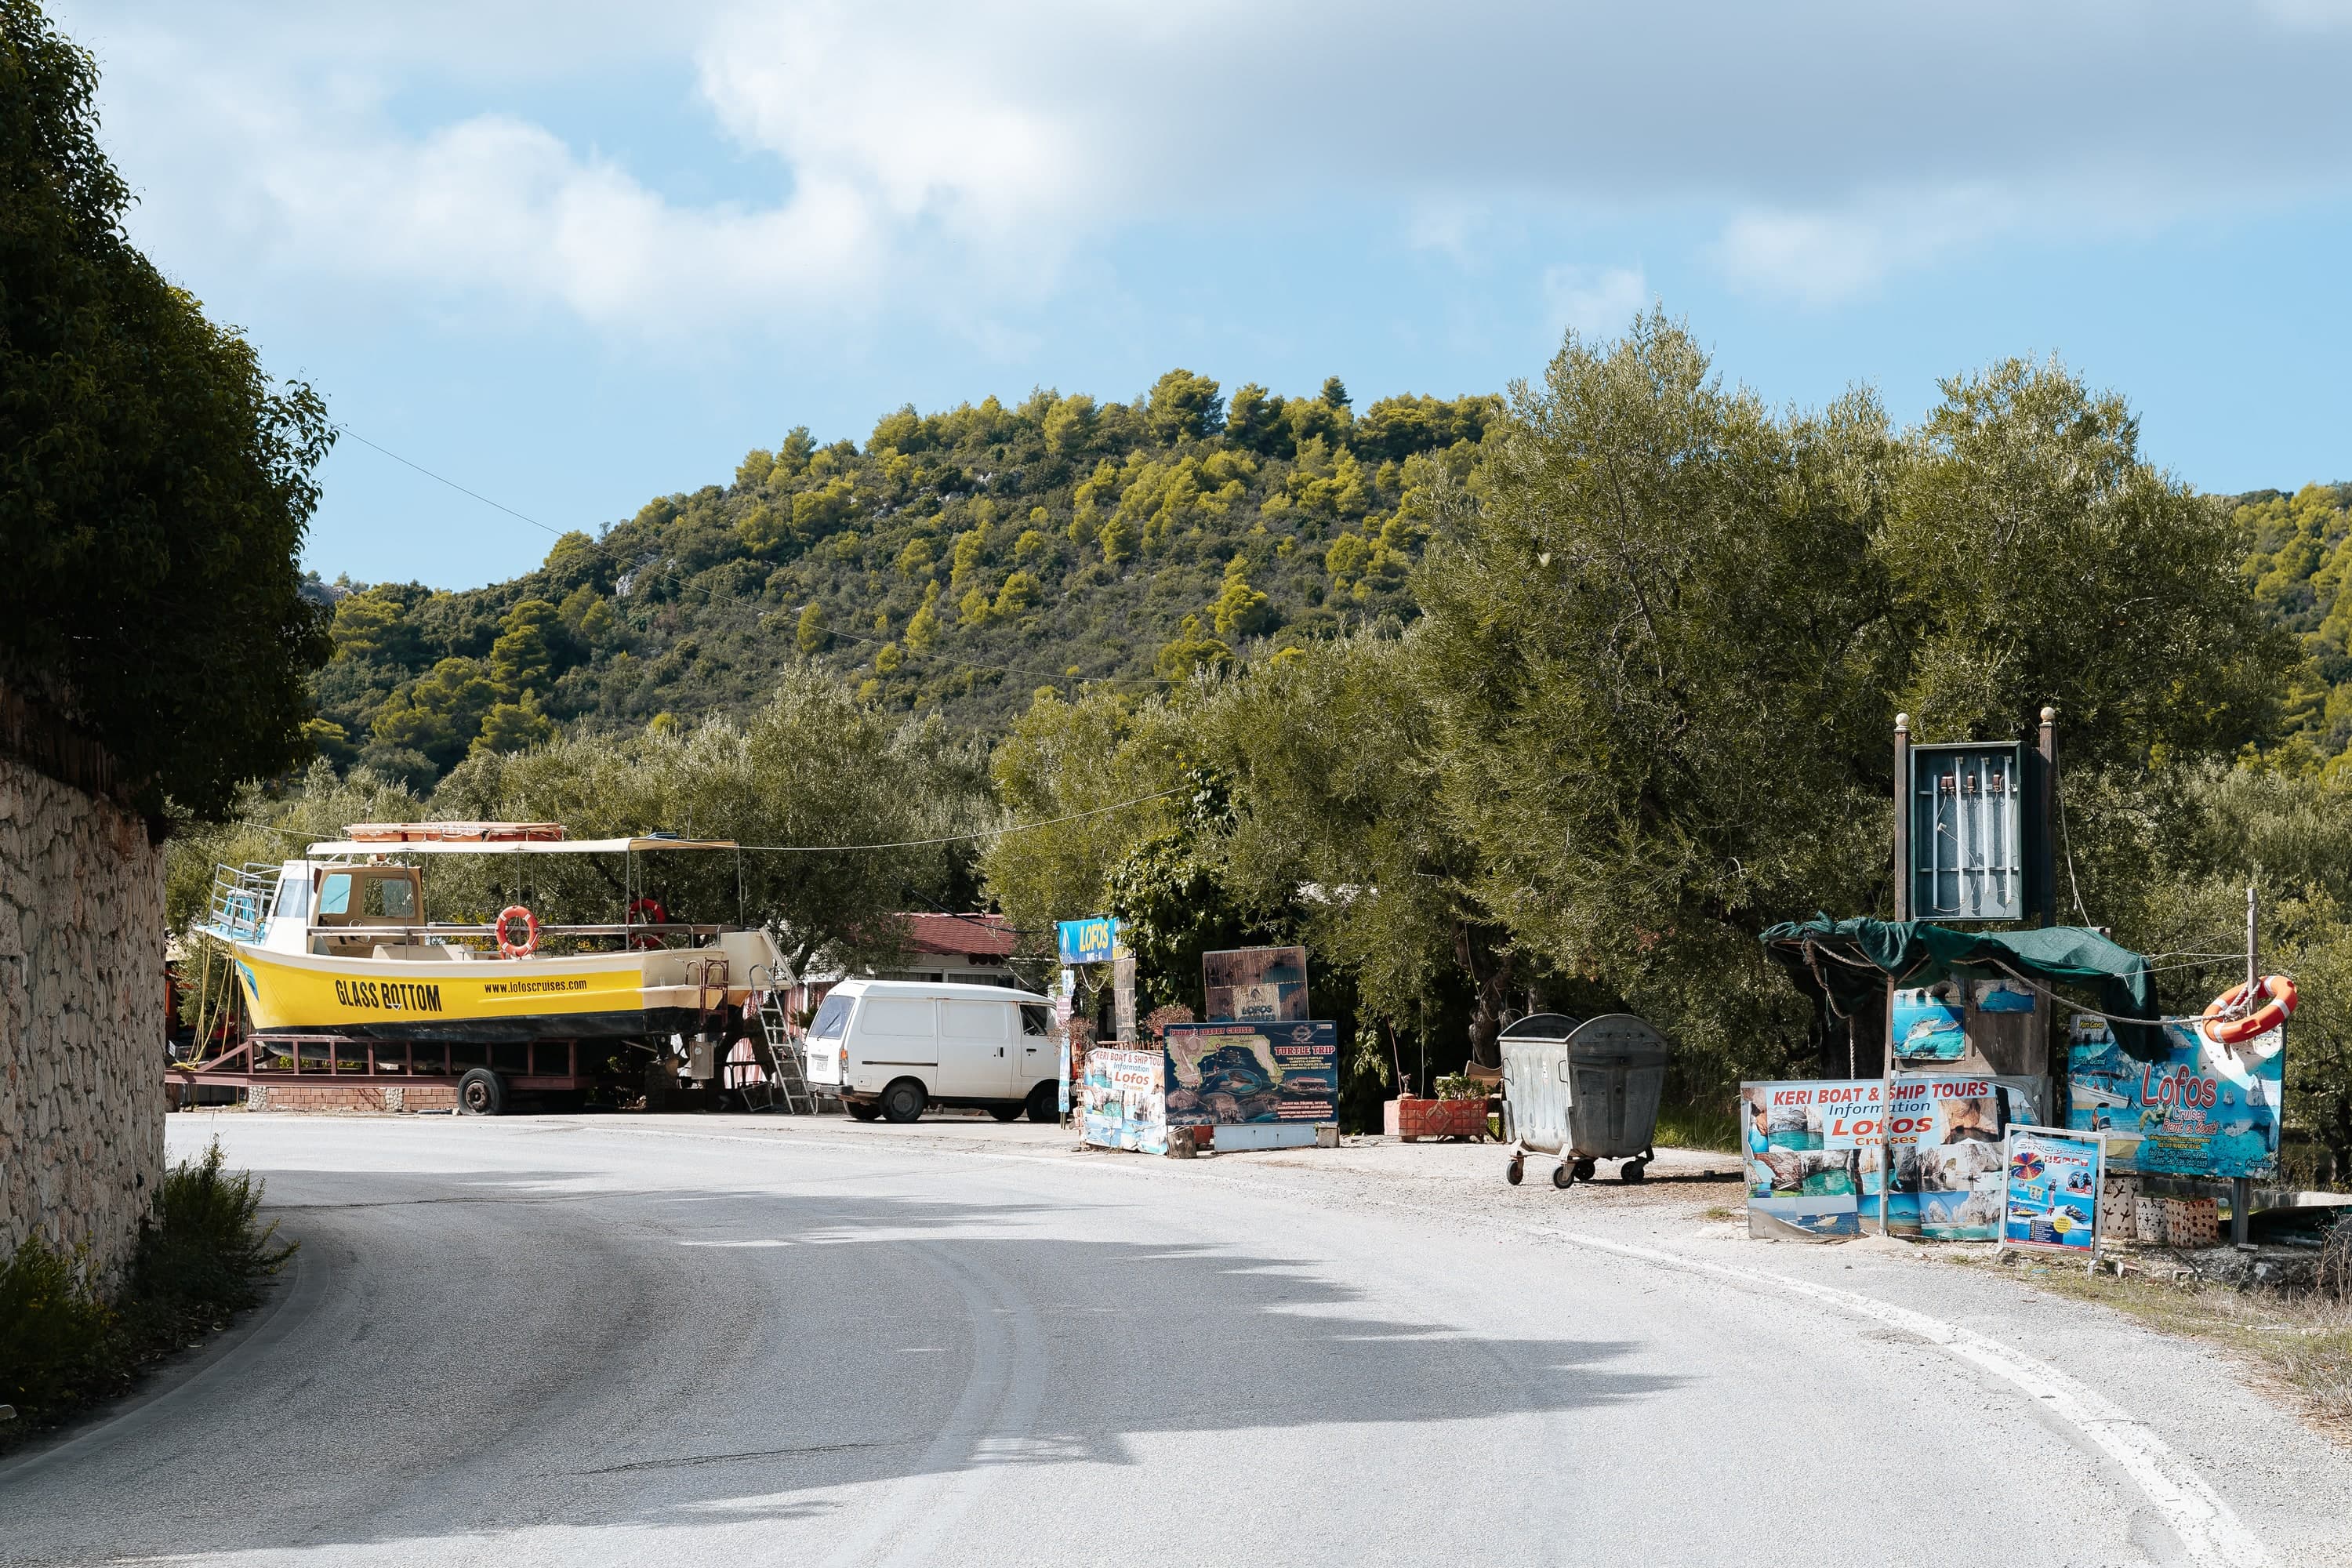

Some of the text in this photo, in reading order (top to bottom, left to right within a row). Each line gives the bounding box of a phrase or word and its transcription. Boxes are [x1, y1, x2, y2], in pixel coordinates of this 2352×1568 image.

[1080, 922, 1109, 952] LOFOS
[485, 979, 587, 993] www.lofoscruises.com
[335, 979, 443, 1012] GLASS BOTTOM
[1200, 1027, 1225, 1036] LUXURY
[1096, 1050, 1109, 1060] KERI
[1110, 1052, 1127, 1062] BOAT
[1128, 1054, 1132, 1063] &
[1134, 1054, 1148, 1064] SHIP
[1275, 1045, 1335, 1056] TURTLE TRIP
[1113, 1062, 1149, 1073] Information
[1114, 1071, 1149, 1086] Lofos
[2141, 1063, 2218, 1108] Lofos
[1773, 1082, 1988, 1105] KERI BOAT & SHIP TOURS
[2173, 1106, 2206, 1120] Cruises
[2161, 1119, 2183, 1133] Rent
[2186, 1122, 2194, 1132] a
